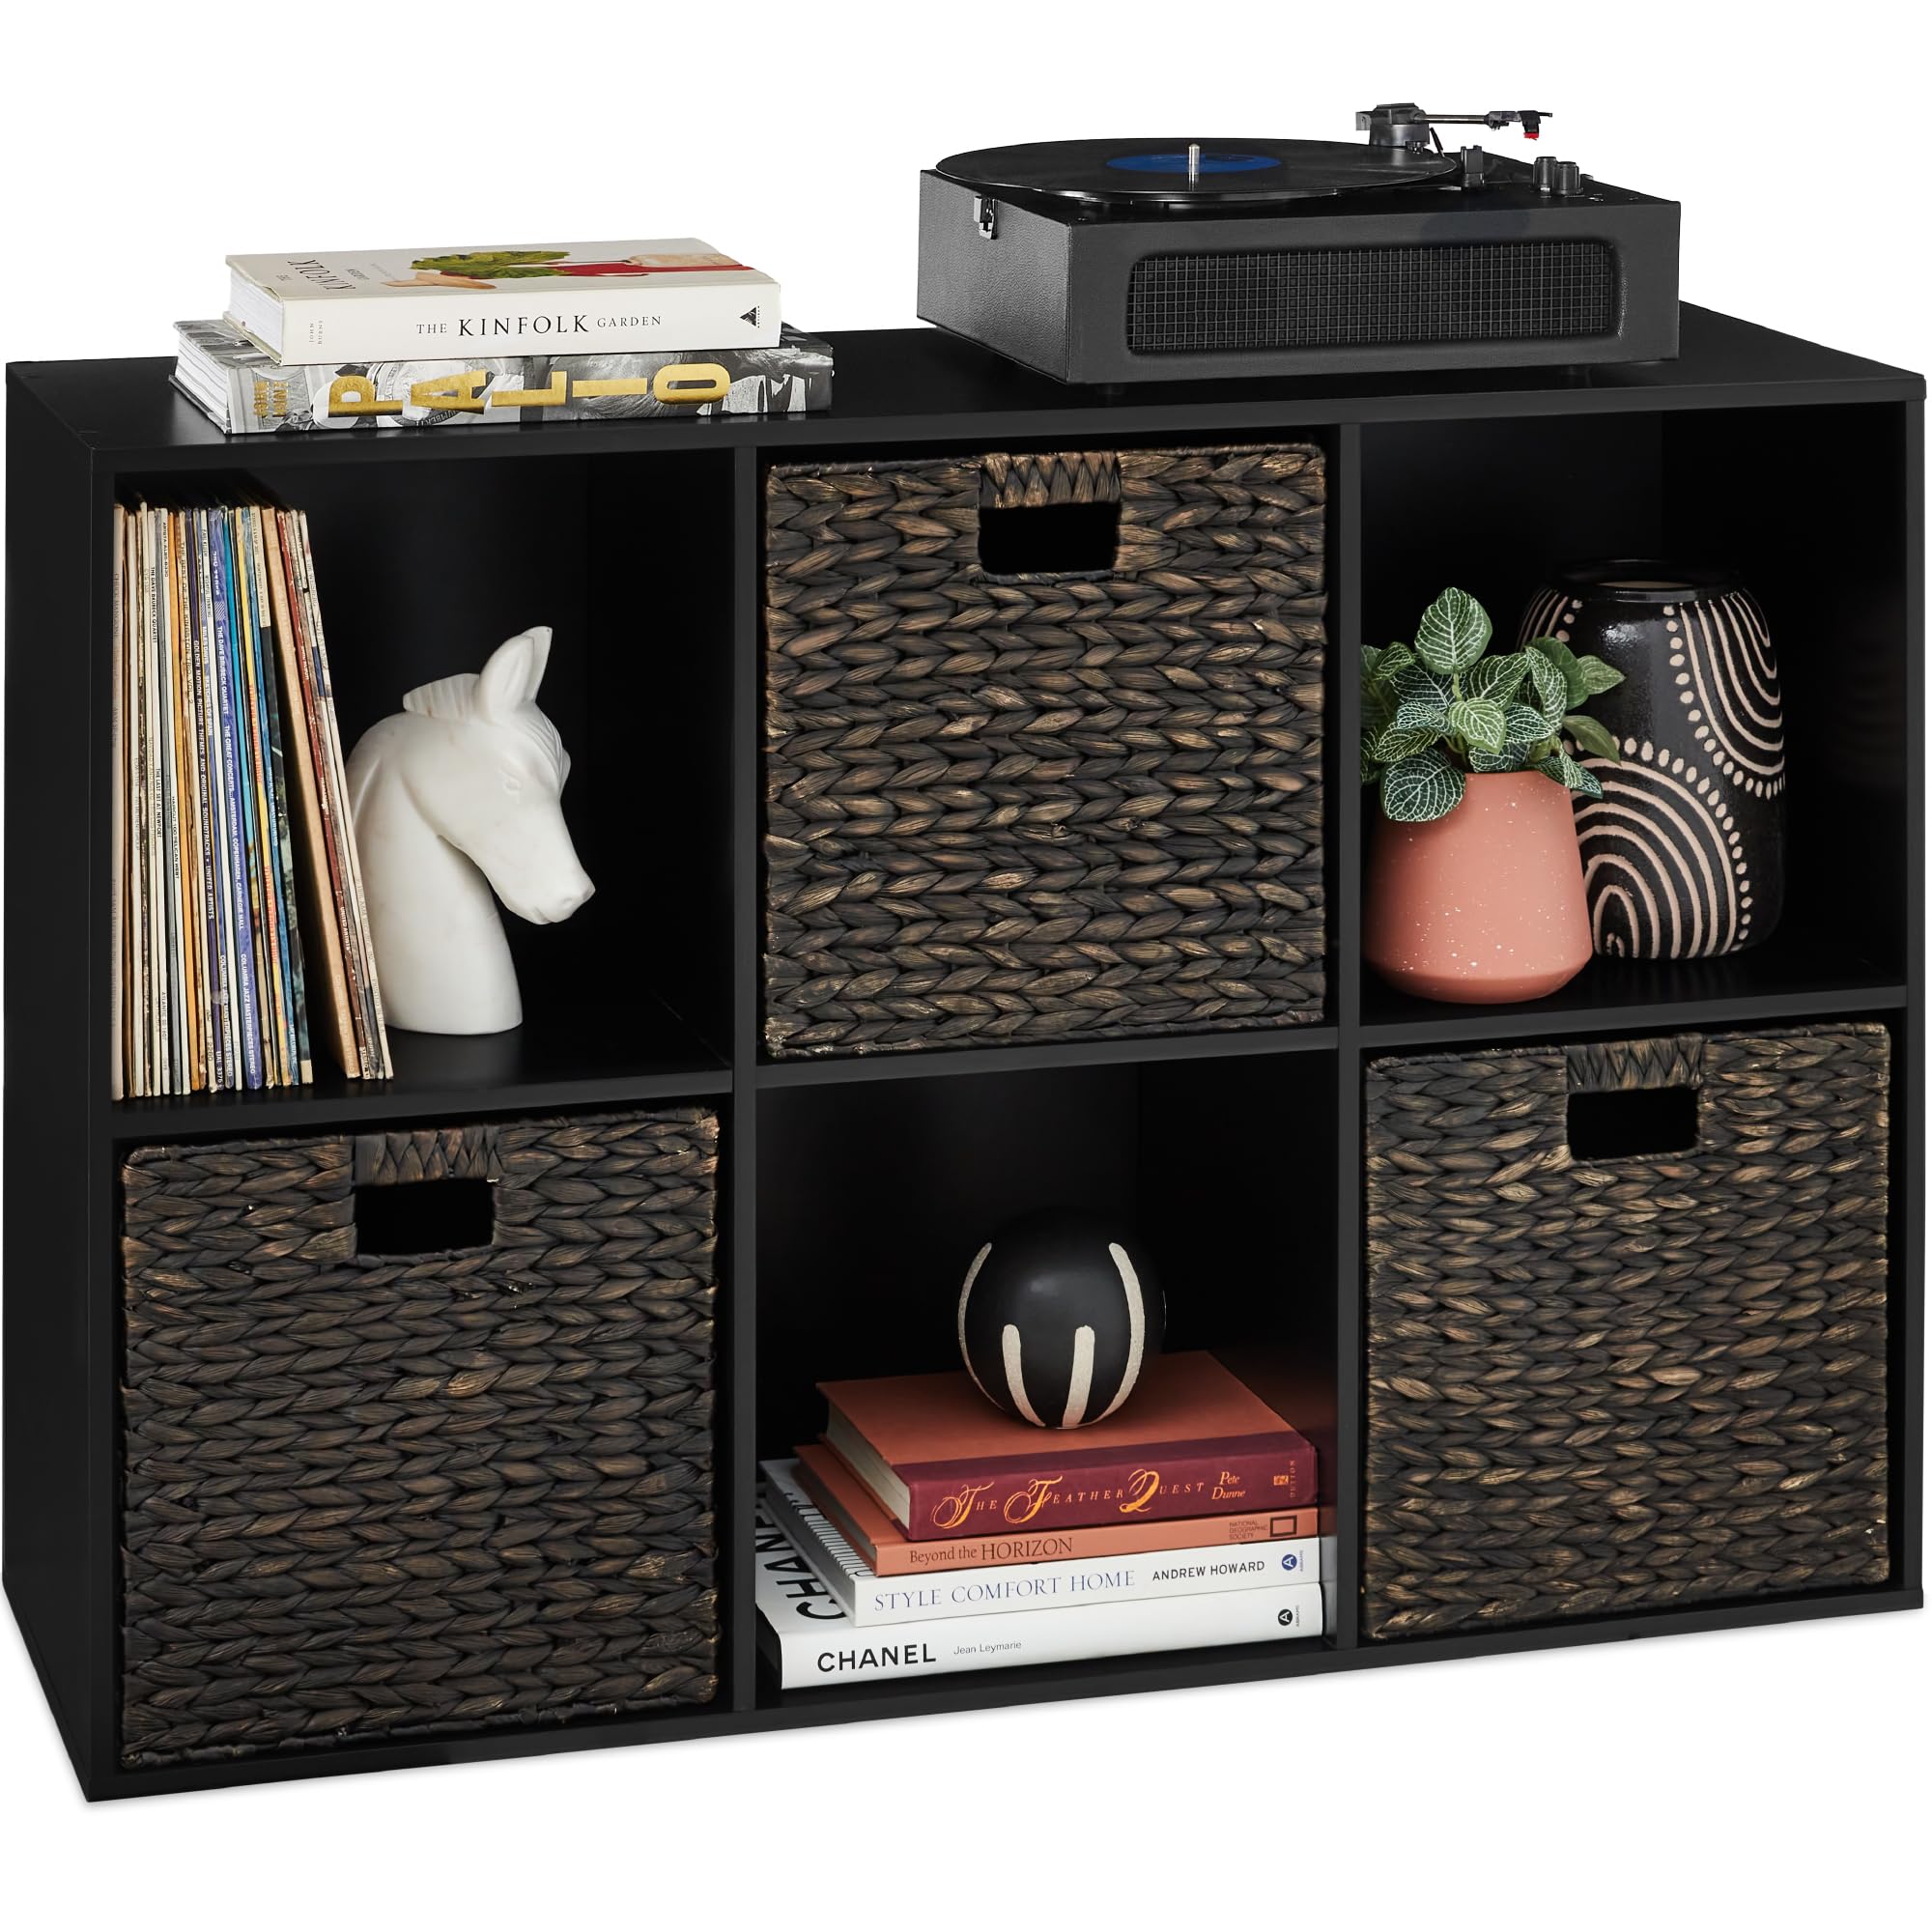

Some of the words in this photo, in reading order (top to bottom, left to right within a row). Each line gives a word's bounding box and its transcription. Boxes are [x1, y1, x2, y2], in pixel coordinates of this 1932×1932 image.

[287, 259, 355, 290] KINFOLK
[416, 323, 447, 334] THE
[458, 315, 590, 337] KINFOLK
[597, 316, 662, 328] GARDEN
[328, 362, 731, 418] PALIO
[183, 582, 187, 593] OF
[218, 655, 227, 686] BRUBECK
[202, 807, 211, 856] SOUNDTRACKS
[244, 1004, 253, 1050] MASTERPIECES
[1210, 1486, 1246, 1500] Dunne
[1218, 1471, 1241, 1486] Pete
[930, 1481, 997, 1529] THE
[1003, 1474, 1124, 1524] FEATHER
[1119, 1468, 1206, 1514] QUEST
[1229, 1525, 1268, 1534] GEOGRAPHIC
[1229, 1532, 1254, 1541] SOCIETY
[909, 1548, 954, 1566] Beyond
[957, 1546, 978, 1560] the
[980, 1537, 1073, 1561] HORIZON
[1152, 1564, 1206, 1581] ANDREW
[1210, 1560, 1265, 1577] HOWARD
[874, 1588, 942, 1611] STYLE
[952, 1577, 1061, 1604] COMFORT
[1070, 1570, 1136, 1592] HOME
[817, 1643, 936, 1672] CHANEL
[953, 1645, 976, 1656] Jean
[979, 1639, 1022, 1656] Leymarie
